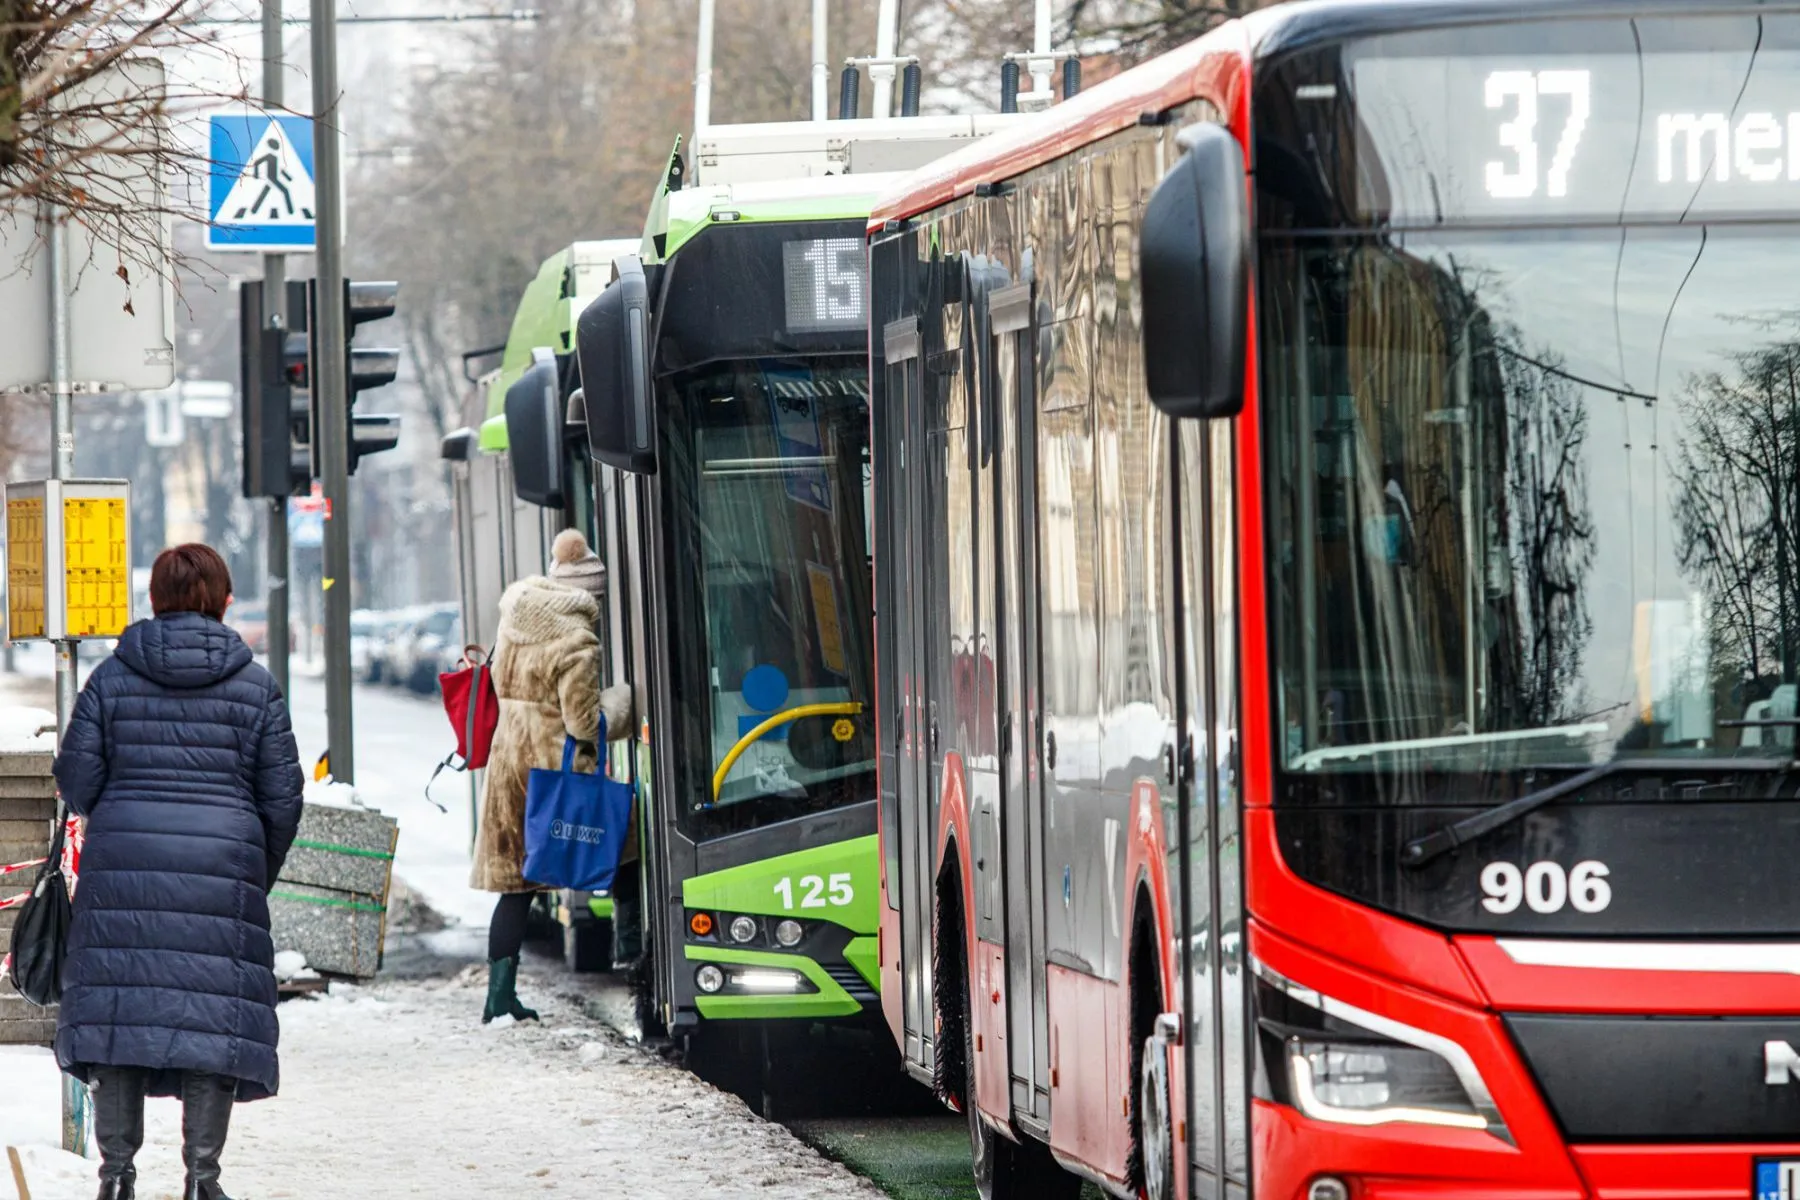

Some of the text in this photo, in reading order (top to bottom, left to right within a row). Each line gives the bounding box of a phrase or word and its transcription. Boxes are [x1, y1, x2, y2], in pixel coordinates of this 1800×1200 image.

[1485, 70, 1591, 198] 37
[804, 238, 861, 319] 15
[773, 872, 854, 910] 125
[1480, 860, 1612, 914] 906
